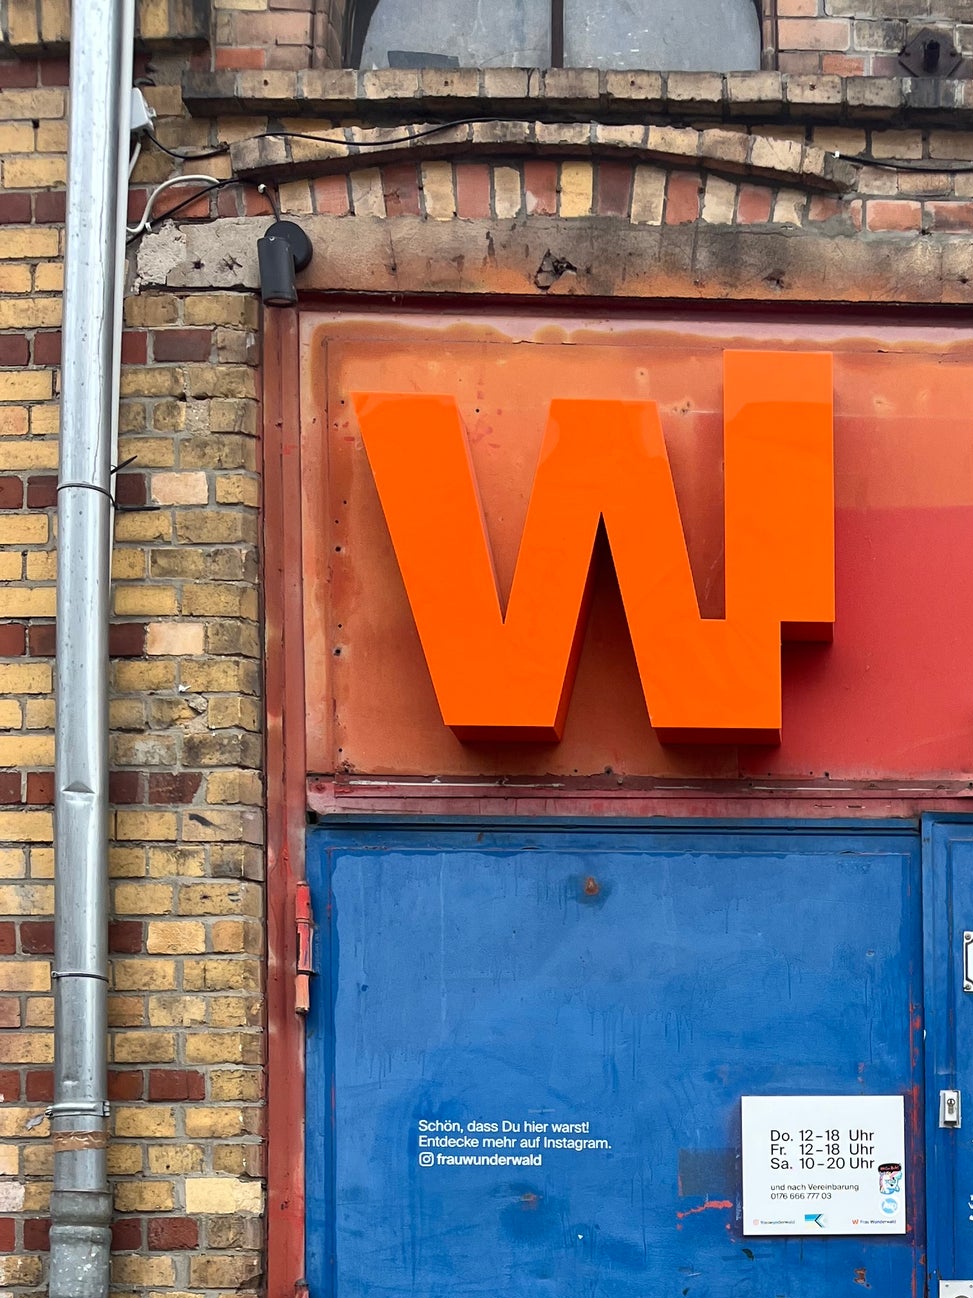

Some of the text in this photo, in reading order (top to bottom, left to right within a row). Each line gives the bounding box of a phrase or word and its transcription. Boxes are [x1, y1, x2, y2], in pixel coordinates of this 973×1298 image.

[351, 348, 836, 744] W
[418, 1119, 590, 1134] Schön, dass Du hier warst!
[770, 1129, 794, 1142] Do.
[848, 1128, 875, 1142] Uhr
[418, 1135, 612, 1152] Entdecke mehr auf Instagram.
[770, 1143, 787, 1156] Fr.
[848, 1142, 875, 1156] Uhr
[436, 1152, 543, 1167] frauwunderwald
[769, 1156, 793, 1170] Sa.
[848, 1156, 875, 1170] Uhr
[807, 1183, 860, 1192] Vereinbarung
[770, 1192, 832, 1200] 0176 666 777 03
